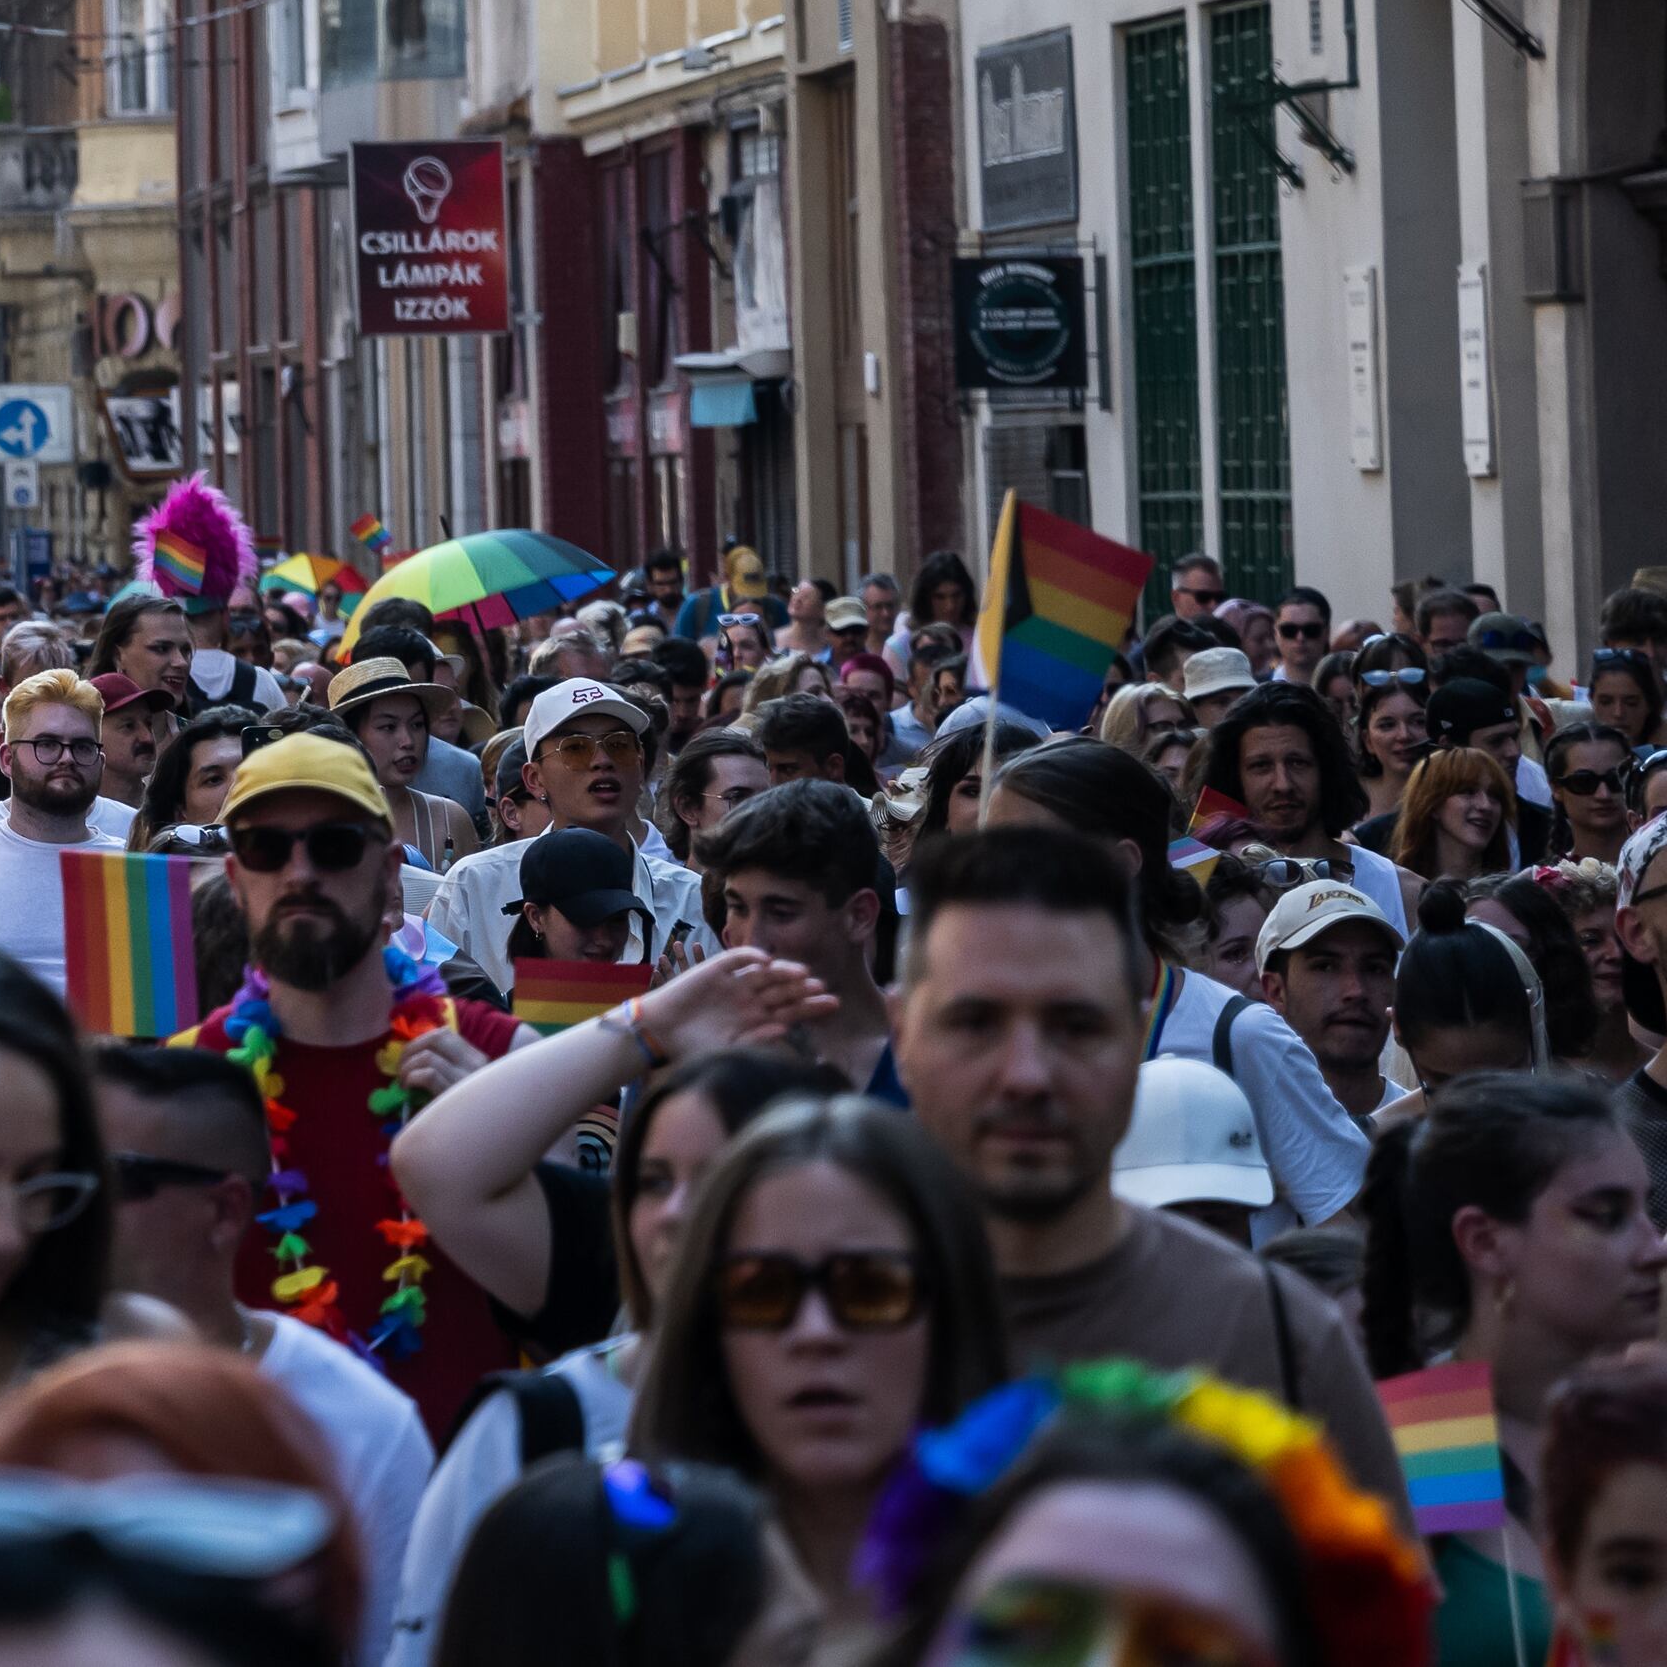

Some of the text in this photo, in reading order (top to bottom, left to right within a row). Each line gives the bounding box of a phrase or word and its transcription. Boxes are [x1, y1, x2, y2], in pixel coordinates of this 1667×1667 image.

[361, 226, 499, 255] CSILLÁROK
[378, 259, 484, 288] LÁMPÁK
[394, 292, 471, 321] IZZÓK
